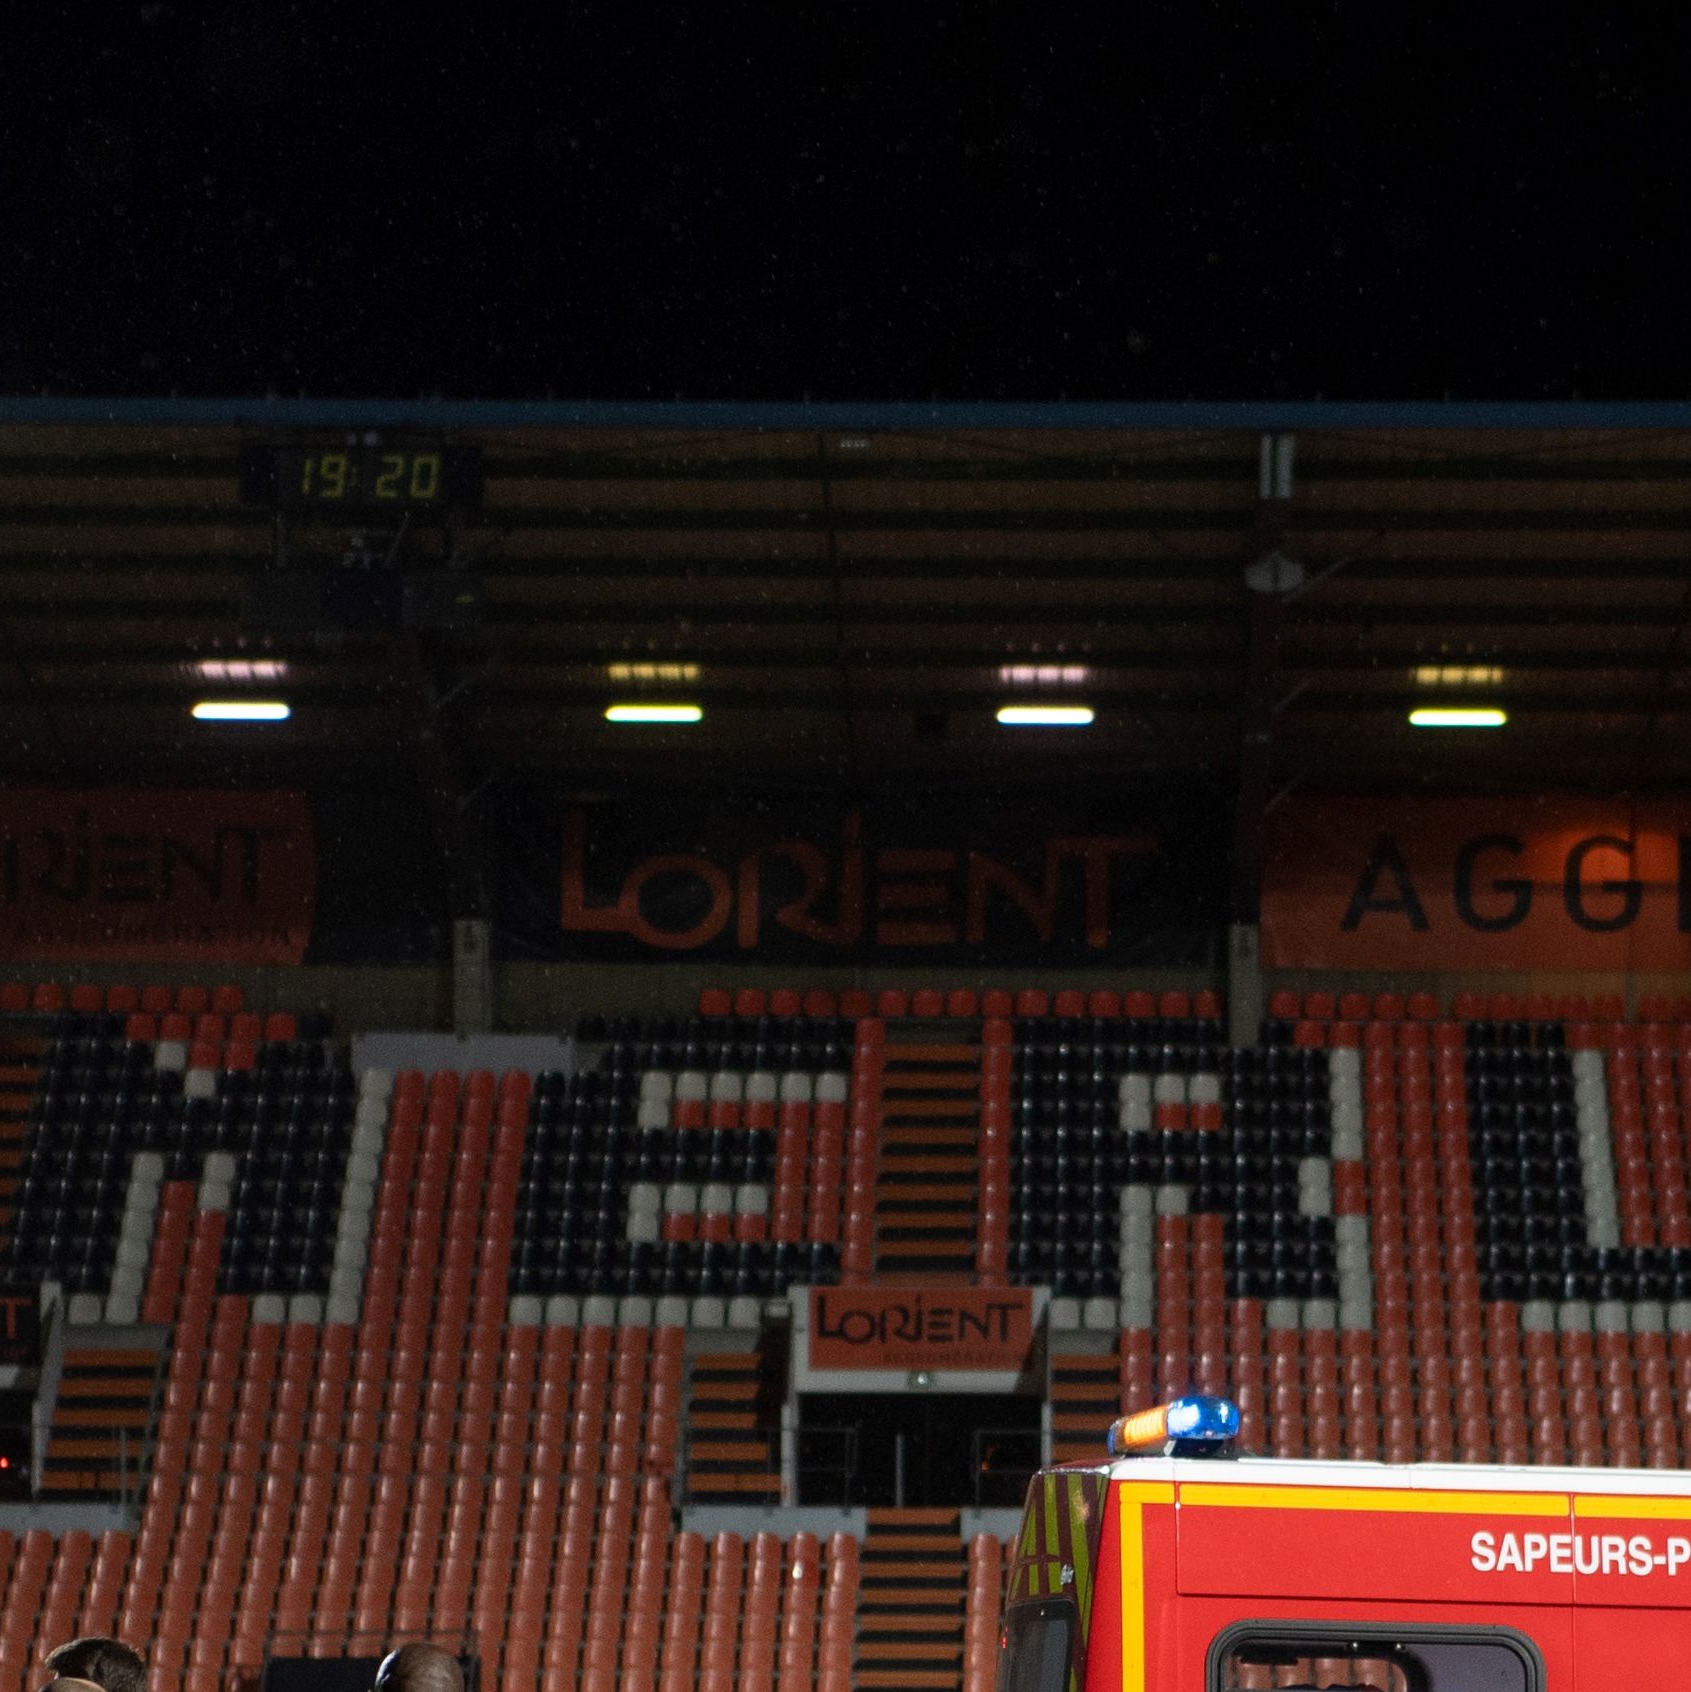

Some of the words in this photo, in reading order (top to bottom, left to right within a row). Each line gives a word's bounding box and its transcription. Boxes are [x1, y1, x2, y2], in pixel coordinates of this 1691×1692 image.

[300, 453, 348, 499] 19
[374, 453, 443, 499] 20
[559, 806, 1157, 951] LORIENT
[816, 1293, 1023, 1345] LORIENT
